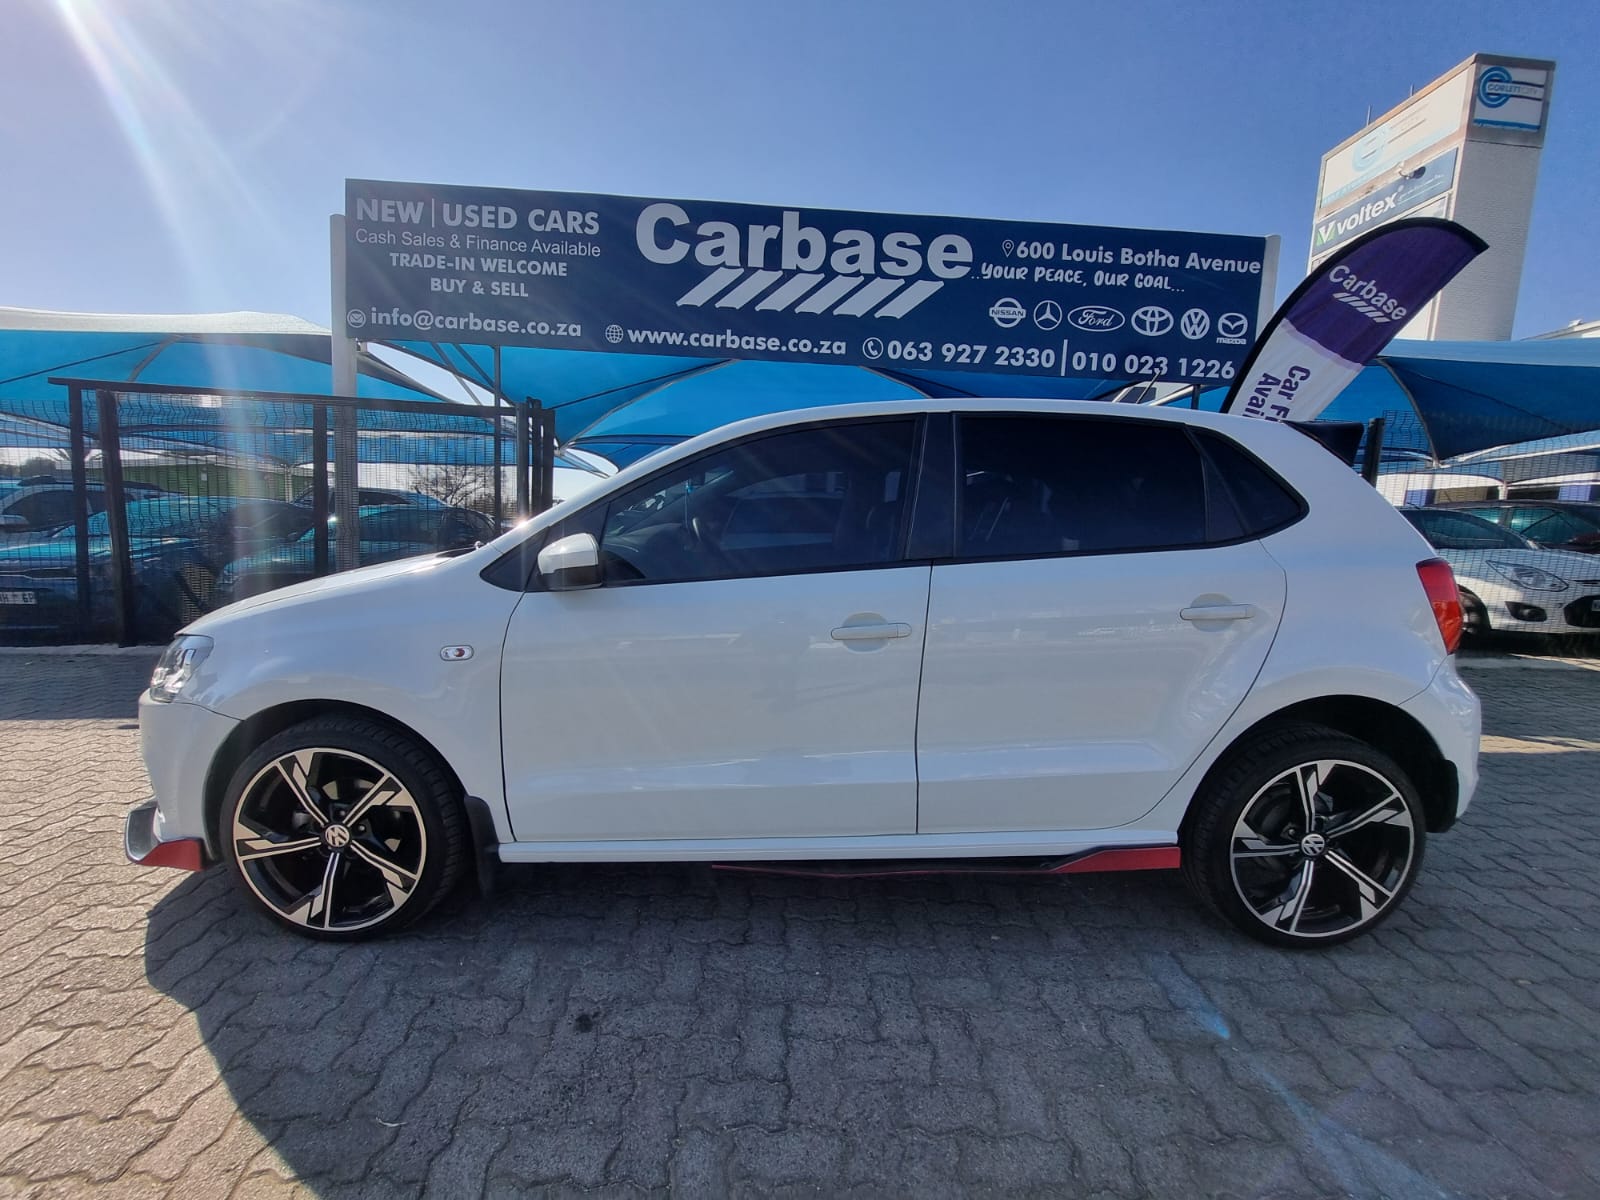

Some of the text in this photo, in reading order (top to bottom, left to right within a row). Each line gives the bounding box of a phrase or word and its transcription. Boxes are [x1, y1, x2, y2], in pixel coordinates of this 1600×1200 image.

[356, 198, 600, 235] NEW USED CARS
[1336, 191, 1399, 236] voltex
[355, 228, 601, 257] Cash Sales & Finance Available
[635, 202, 974, 280] Carbase
[389, 252, 568, 277] TRADE-IN WELCOME
[1016, 241, 1262, 274] 600 Louis Botha Avenue
[430, 278, 529, 298] BUY & SELL
[1328, 265, 1407, 321] Carbase
[371, 307, 582, 337] info@carbase.co.za
[990, 308, 1025, 318] NISSAN
[1078, 309, 1115, 327] Ford
[627, 328, 847, 355] www.carbase.co.za
[887, 339, 1235, 379] 063 927 2330 010 023 1226
[1278, 365, 1311, 400] Car
